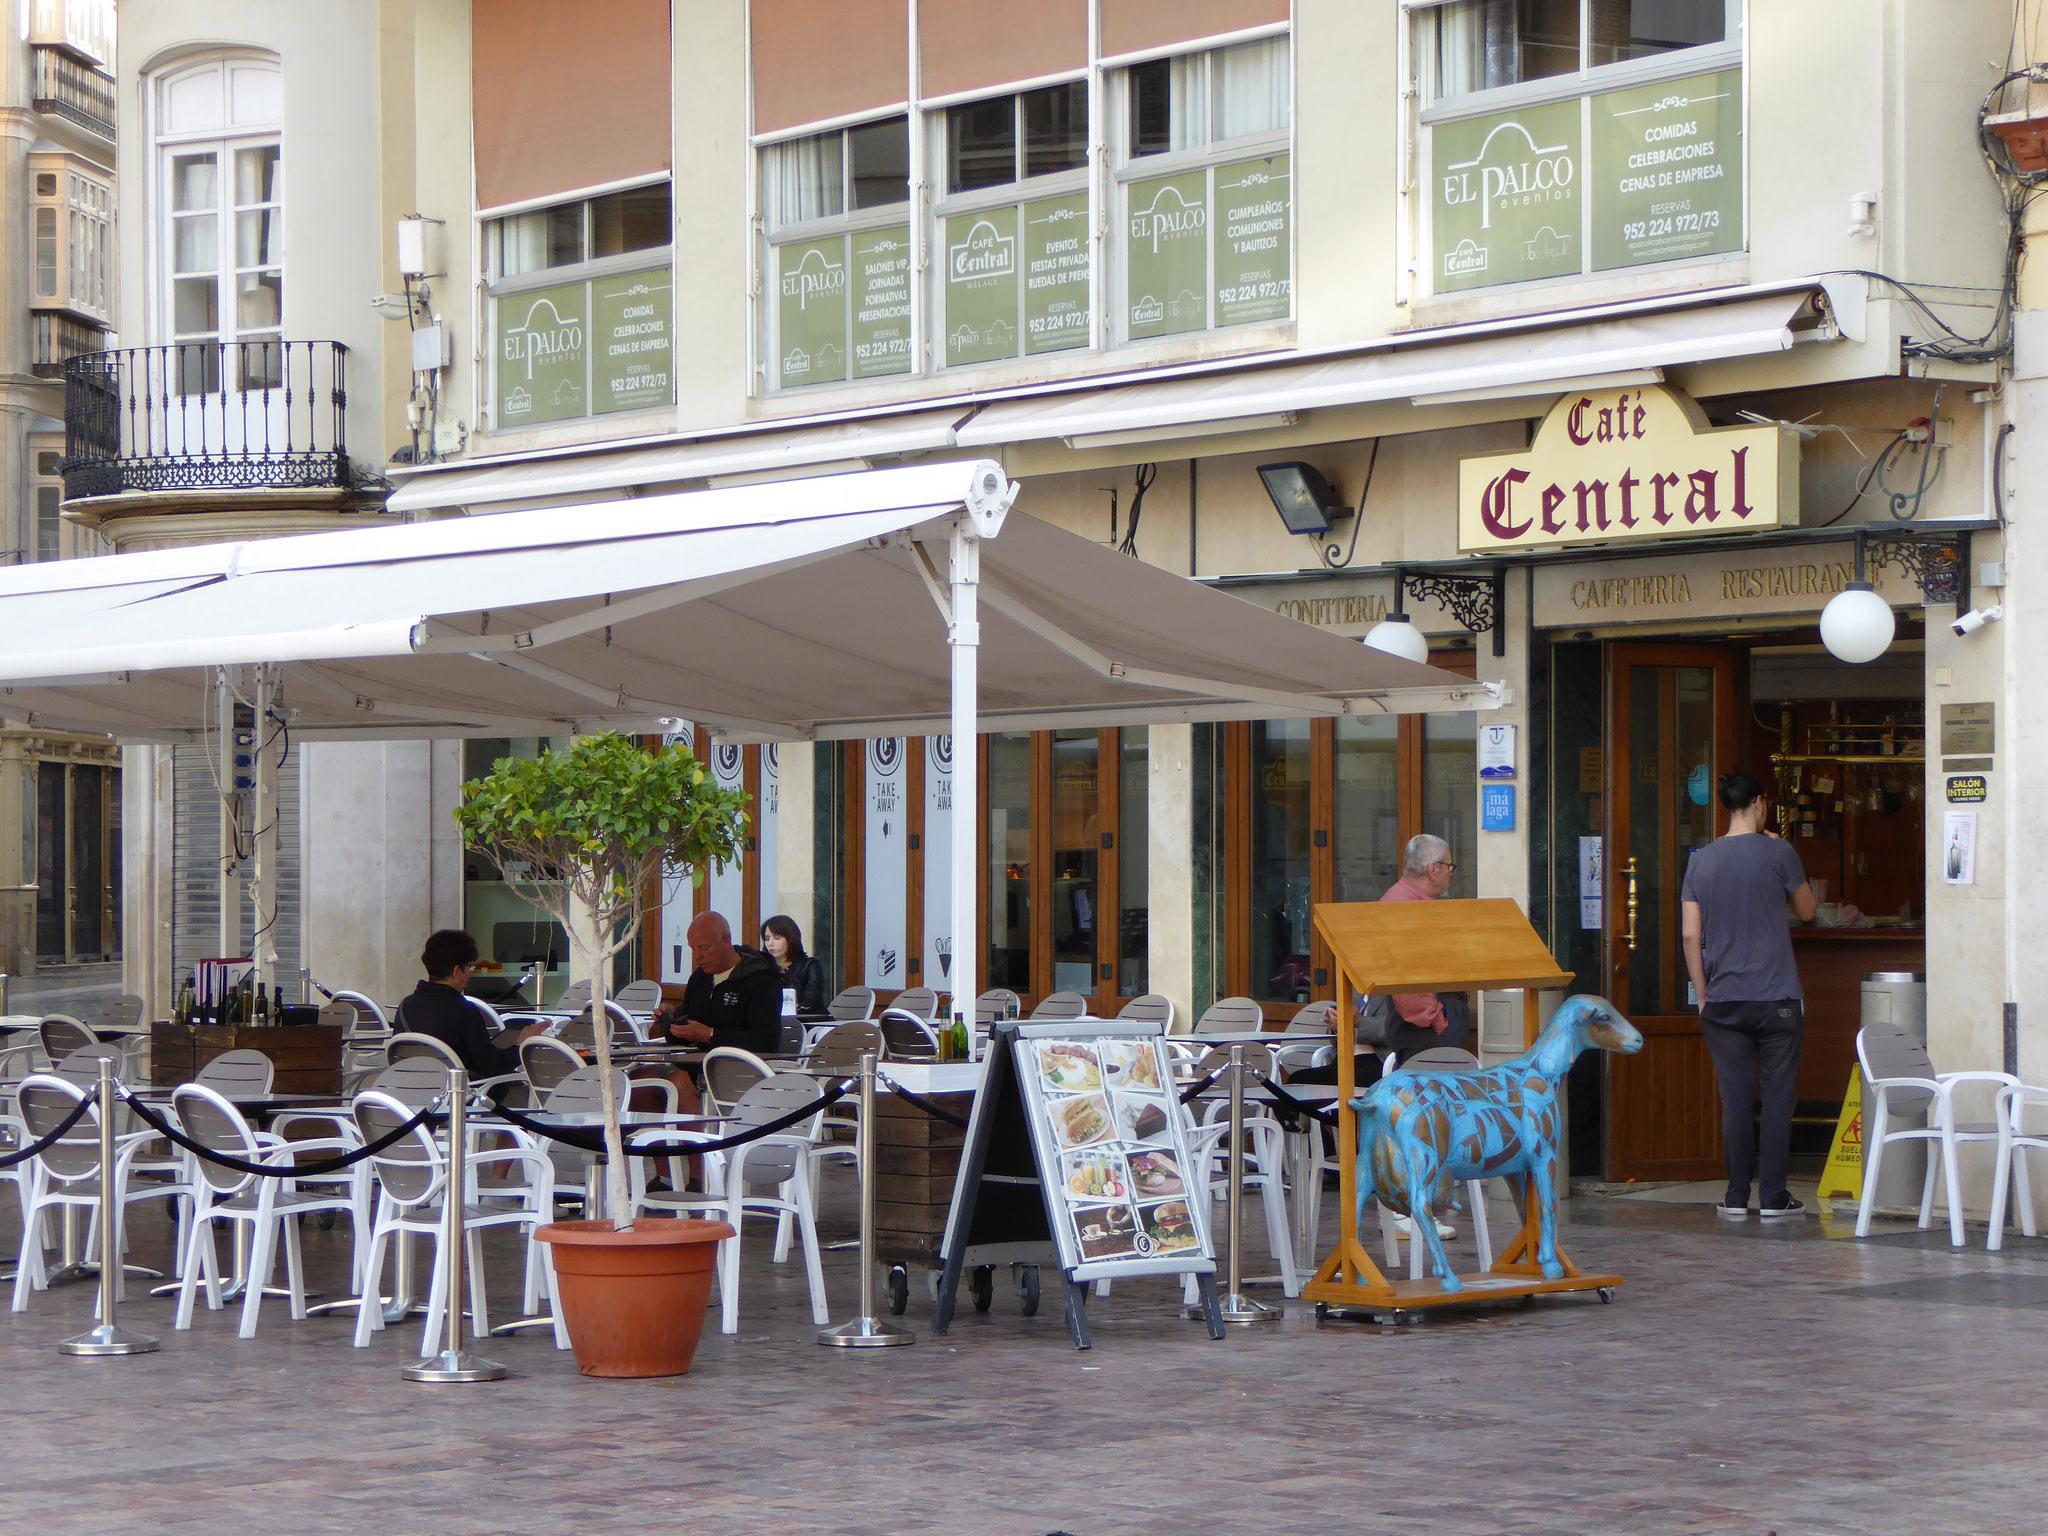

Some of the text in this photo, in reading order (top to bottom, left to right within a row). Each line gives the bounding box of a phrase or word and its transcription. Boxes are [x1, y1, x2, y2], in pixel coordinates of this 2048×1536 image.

[1645, 121, 1697, 142] COMIDAS
[1628, 142, 1714, 168] CELEBRACIONES
[1620, 164, 1723, 193] CENAS DE EMPRESA
[1443, 156, 1573, 229] EL PALCO
[1501, 188, 1571, 209] eventos
[1228, 200, 1283, 221] CUMPLEAÑOS
[1650, 200, 1691, 215] RESERVAS
[1131, 208, 1205, 253] EL PALCO
[1228, 218, 1283, 238] COMUNIONES
[1624, 222, 1645, 240] 952
[1649, 218, 1672, 236] 224
[1676, 210, 1720, 232] 972/73
[972, 235, 993, 250] CAFÉ
[1046, 238, 1078, 254] EVENTOS
[1233, 237, 1277, 254] Y BAUTIZOS
[865, 258, 908, 276] SALONES VIP
[956, 248, 1009, 274] Central
[1031, 252, 1089, 273] FIESTAS PRIVADA
[868, 275, 904, 290] JORNADAS
[1028, 269, 1090, 289] RUEDAS DE PRENS
[1240, 269, 1271, 283] RESERVAS
[782, 269, 845, 311] EL PALCO
[865, 290, 907, 306] FORMATIVAS
[1219, 289, 1236, 304] 952
[1238, 286, 1256, 301] 224
[623, 304, 654, 319] COMIDAS
[858, 305, 912, 323] PRESENTACIONE
[1048, 300, 1077, 312] RESERVAS
[613, 320, 664, 338] CELEBRACIONES
[1029, 311, 1089, 333] 952 224 972/7
[873, 327, 899, 339] RESERVAS
[504, 326, 582, 380] EL PALCO
[608, 338, 669, 356] CENAS DE EMPRESA
[856, 338, 912, 358] 952 224 972/7
[626, 363, 650, 374] RESERVAS
[611, 373, 667, 392] 952 224 972/73
[1568, 389, 1647, 446] Café
[1480, 446, 1754, 540] Central
[1720, 561, 1884, 600] RESTAURANE
[1570, 574, 1692, 609] CAFETERIA
[877, 783, 895, 796] TAKE
[937, 781, 952, 795] TAK
[1952, 777, 1980, 788] SALÓN
[1947, 788, 1985, 797] INTERIOR
[877, 798, 895, 812] AWAY
[937, 796, 952, 811] AWA
[1835, 1154, 1861, 1162] HUMED
[1840, 1145, 1861, 1153] SUEL
